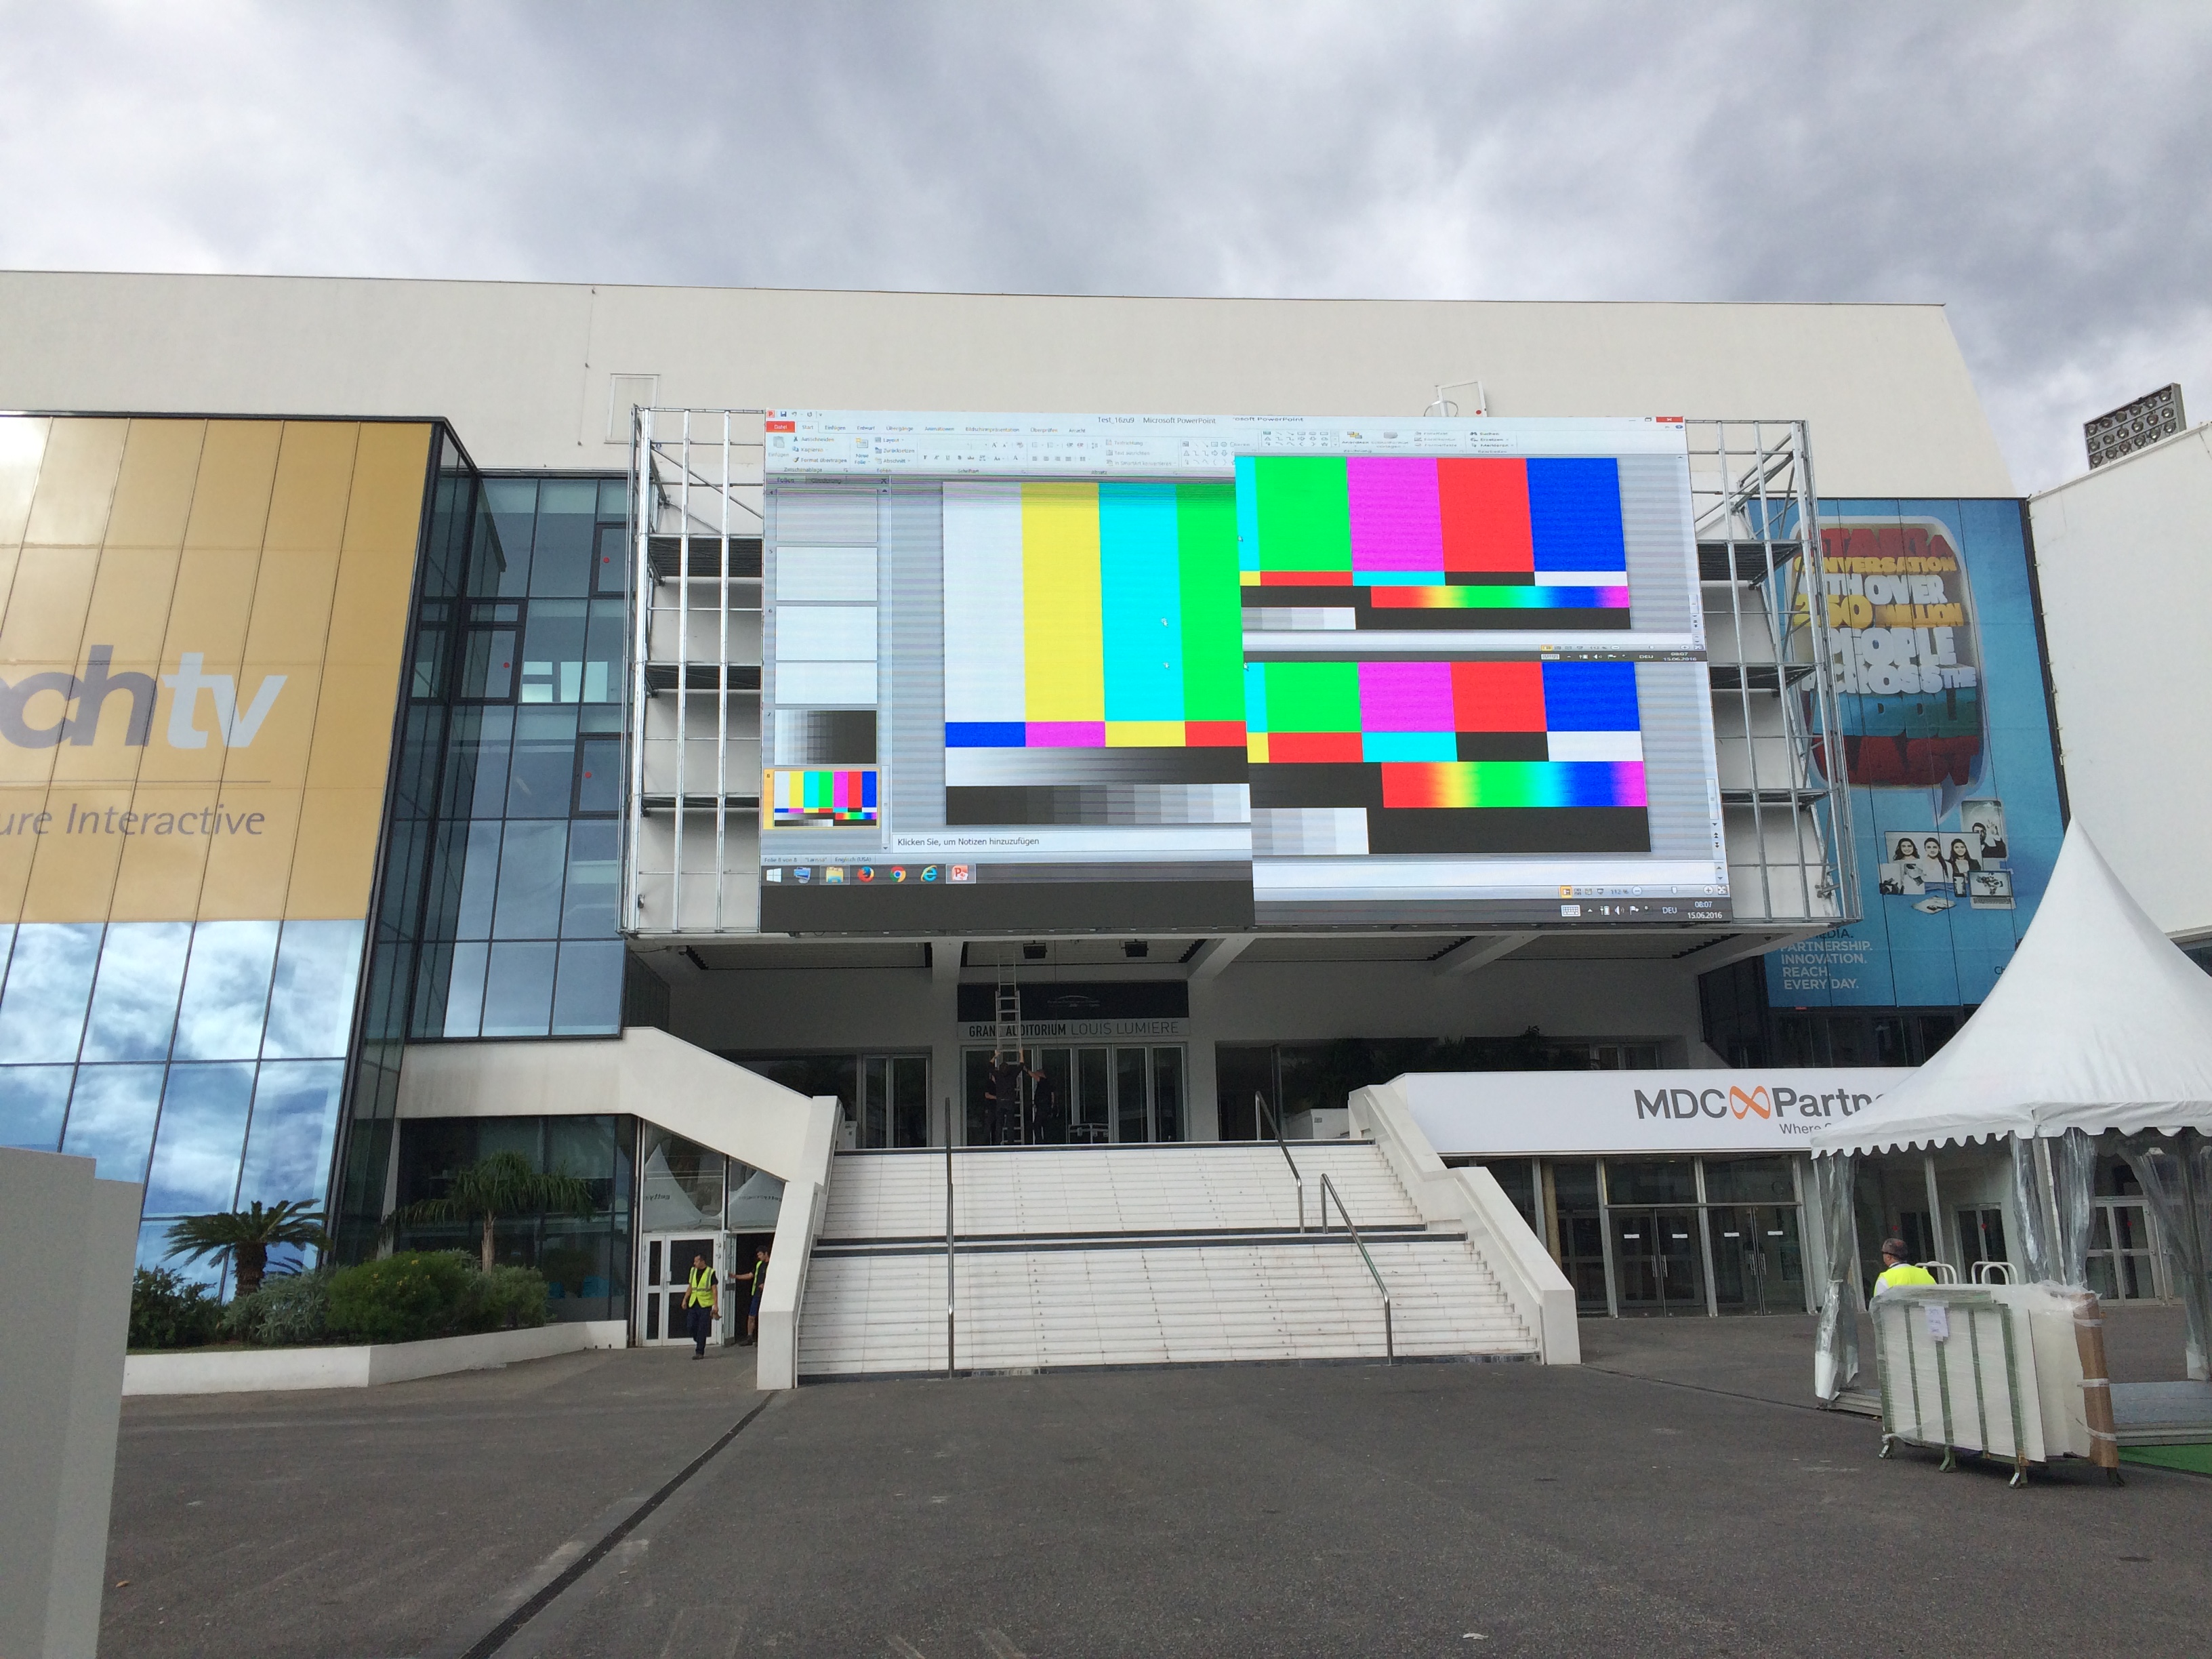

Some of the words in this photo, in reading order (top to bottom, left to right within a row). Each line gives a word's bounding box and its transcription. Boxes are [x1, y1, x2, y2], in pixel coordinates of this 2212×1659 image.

[1808, 528, 1929, 557] TART
[1794, 556, 1958, 575] CNVERSATION
[1796, 573, 1863, 596] WTH
[1864, 575, 1948, 605] OVER
[66, 802, 265, 836] Interactive
[897, 838, 925, 846] Klicken
[926, 838, 941, 846] Sie,
[958, 838, 987, 846] Notizen
[989, 837, 1040, 846] hinzuzufügen
[1662, 906, 1677, 914] DEU
[1687, 912, 1723, 920] 15.06.2016
[1816, 928, 1854, 939] EDIA.
[1781, 953, 1868, 965] INNOVATION.
[1782, 966, 1831, 977] REACH.
[1784, 979, 1827, 990] EVERY
[1831, 979, 1860, 989] DAY.
[968, 1025, 998, 1038] GRAN
[1071, 1023, 1112, 1036] LOUIS
[1117, 1021, 1179, 1034] LUMIERE
[1634, 1088, 1728, 1120] MDC
[1771, 1087, 1884, 1118] Partn
